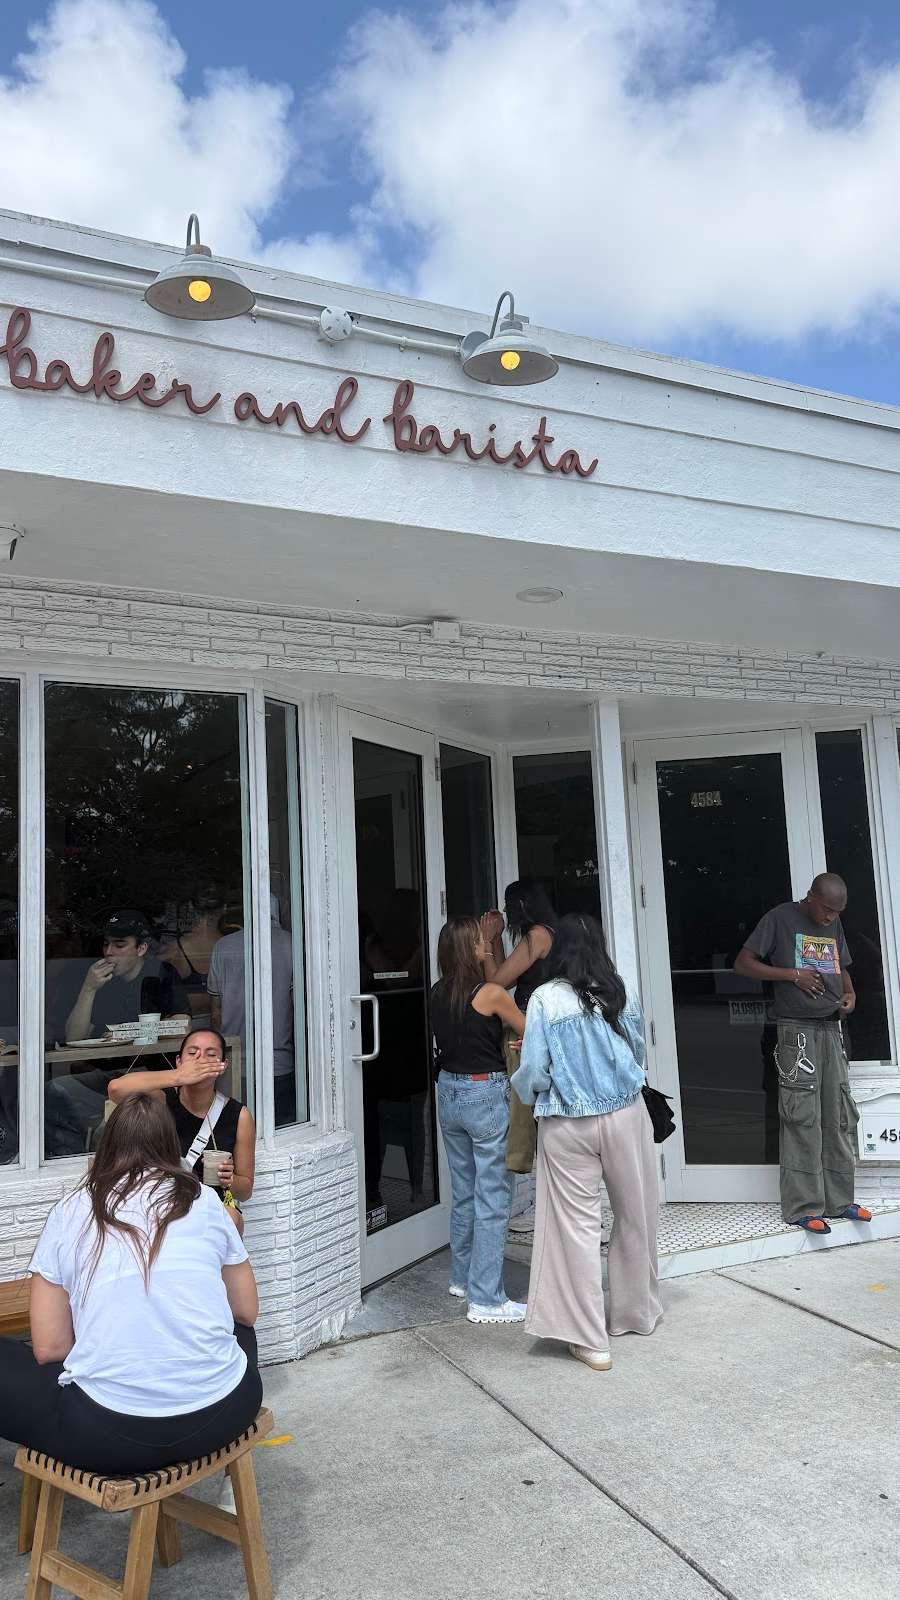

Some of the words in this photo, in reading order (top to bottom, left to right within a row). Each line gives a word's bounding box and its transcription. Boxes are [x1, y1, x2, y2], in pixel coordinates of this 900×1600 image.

[0, 307, 222, 415] baker
[234, 376, 372, 442] and
[383, 379, 599, 478] barista
[690, 791, 722, 807] 4584
[879, 1128, 900, 1142] 45
